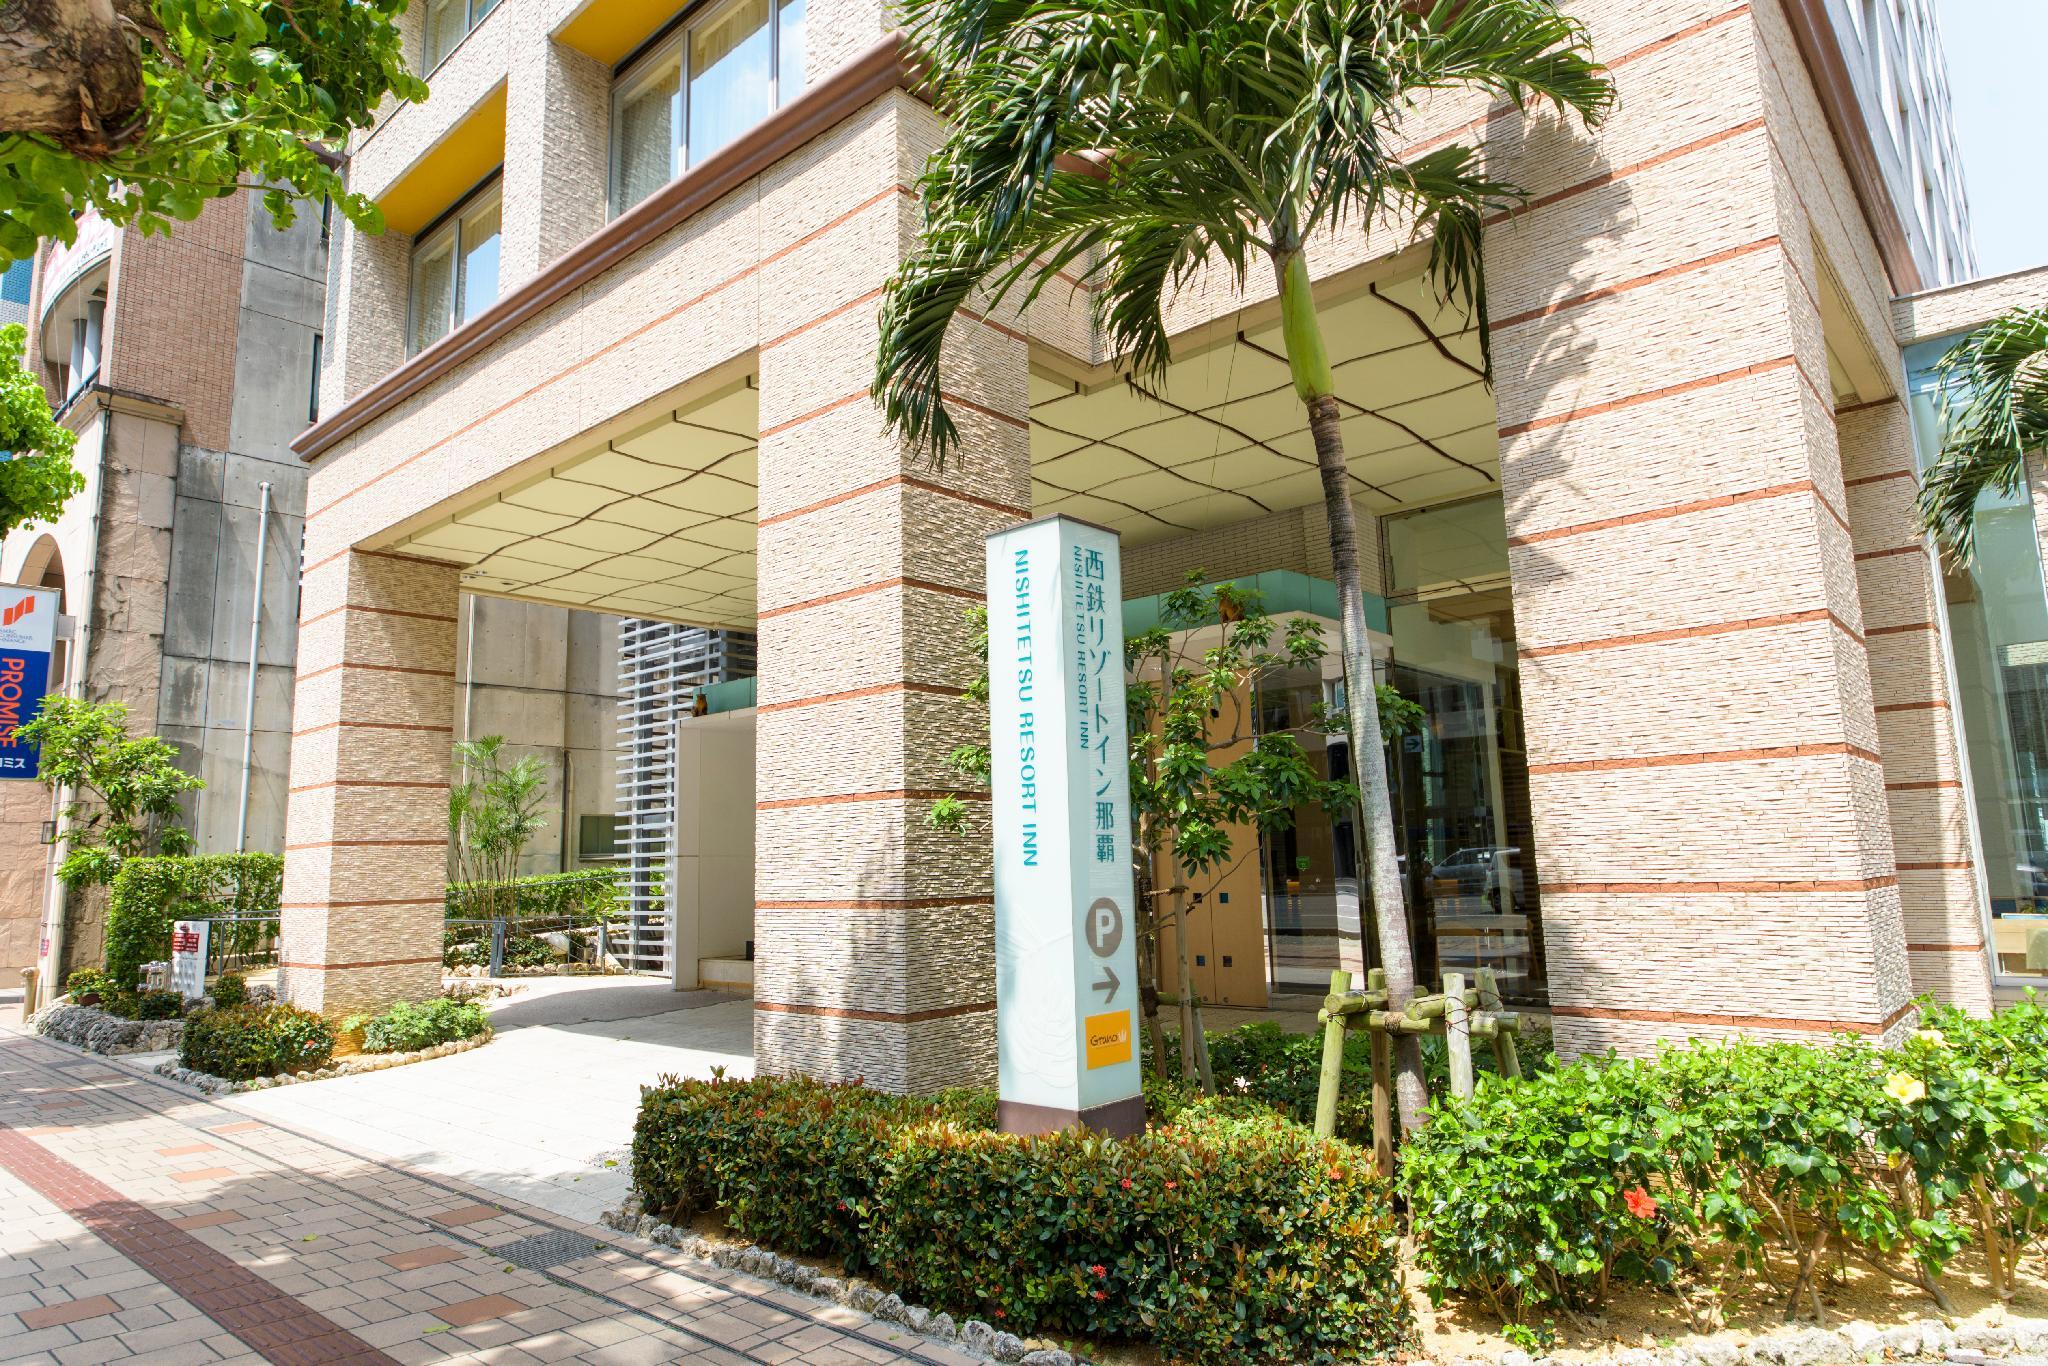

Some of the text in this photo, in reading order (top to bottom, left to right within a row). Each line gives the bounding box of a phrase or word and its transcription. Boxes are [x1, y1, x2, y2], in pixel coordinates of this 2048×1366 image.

[0, 657, 25, 748] PROMISE
[1015, 549, 1038, 867] NISHITETSU RESORT INN
[1073, 545, 1089, 749] NISHITETSU RESORT INN
[1085, 548, 1115, 863] 西鉄リゾートイン那覇
[0, 757, 26, 769] ミス
[1095, 907, 1116, 948] P
